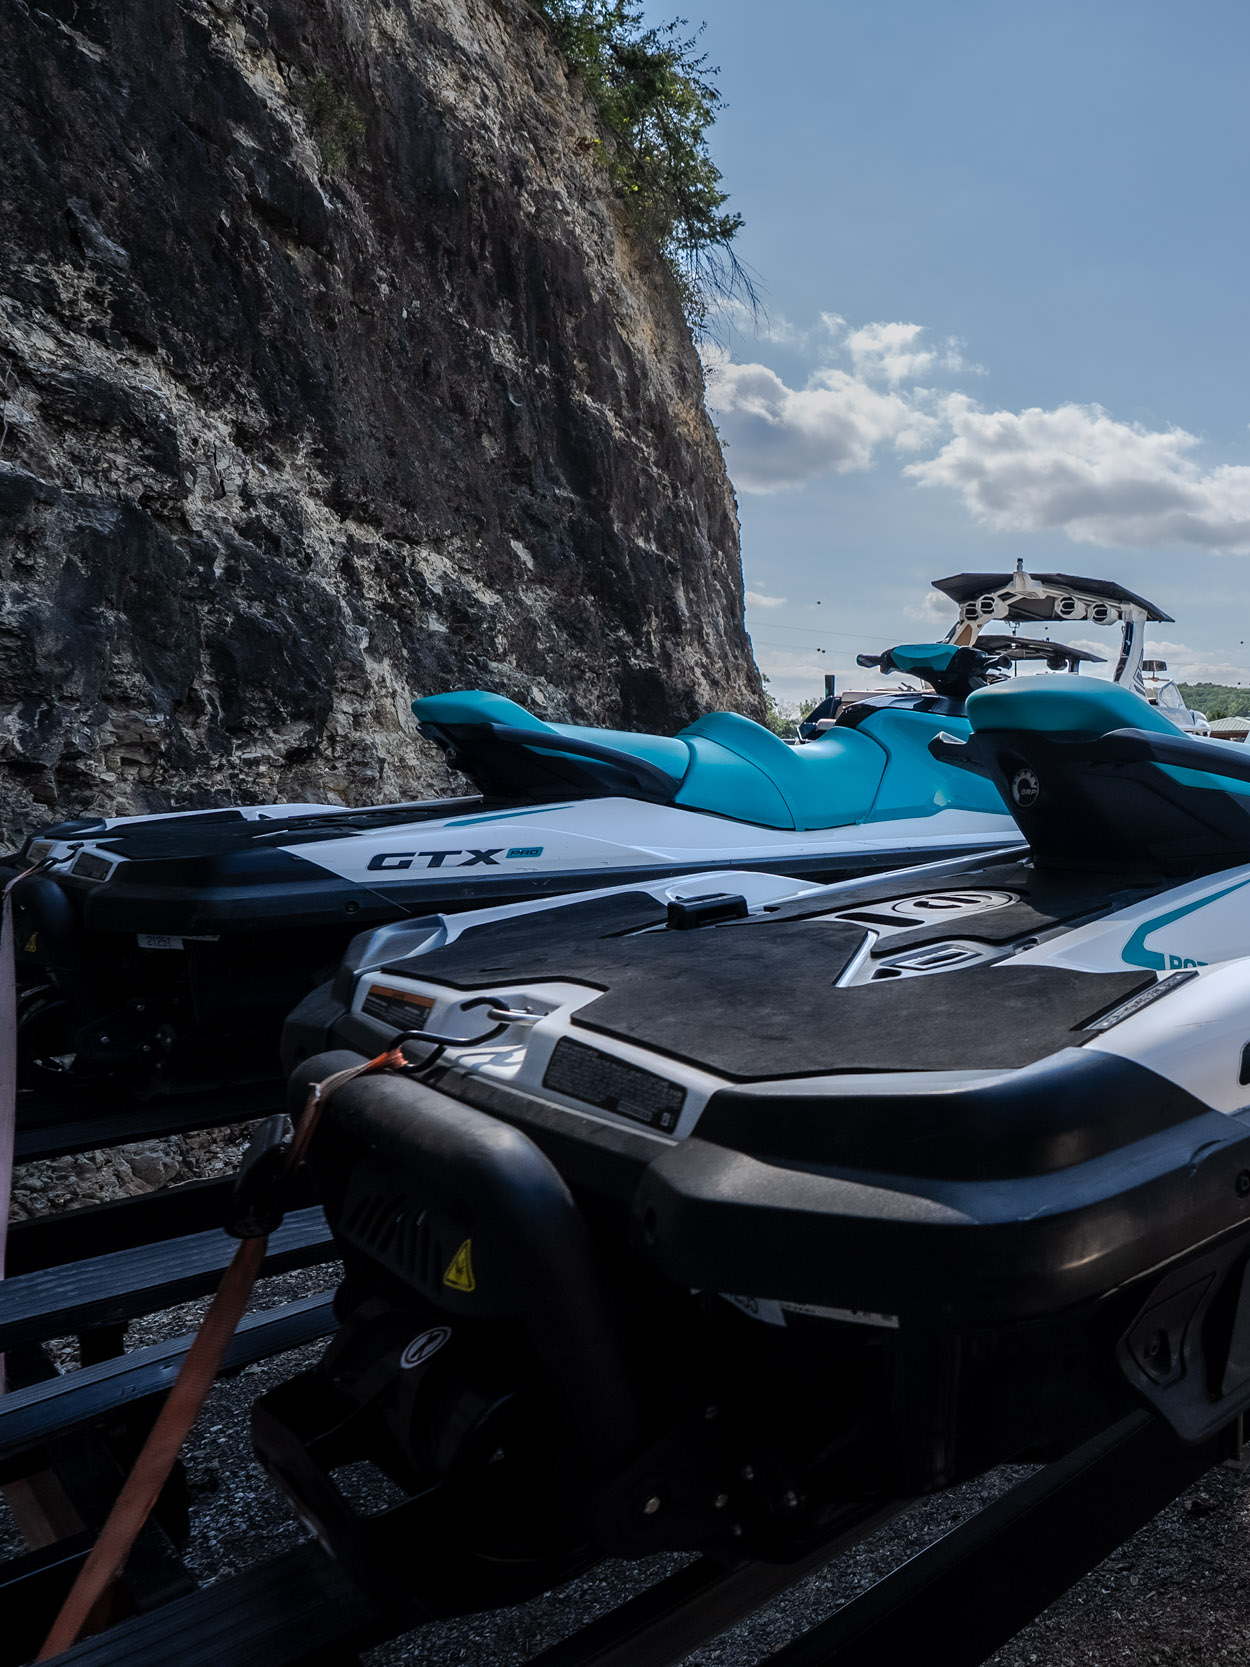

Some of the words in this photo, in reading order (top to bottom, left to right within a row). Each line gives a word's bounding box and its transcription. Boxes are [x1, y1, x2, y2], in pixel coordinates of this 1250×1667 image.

[1020, 787, 1037, 796] BRP
[367, 848, 506, 871] GTX
[509, 848, 540, 857] PRO
